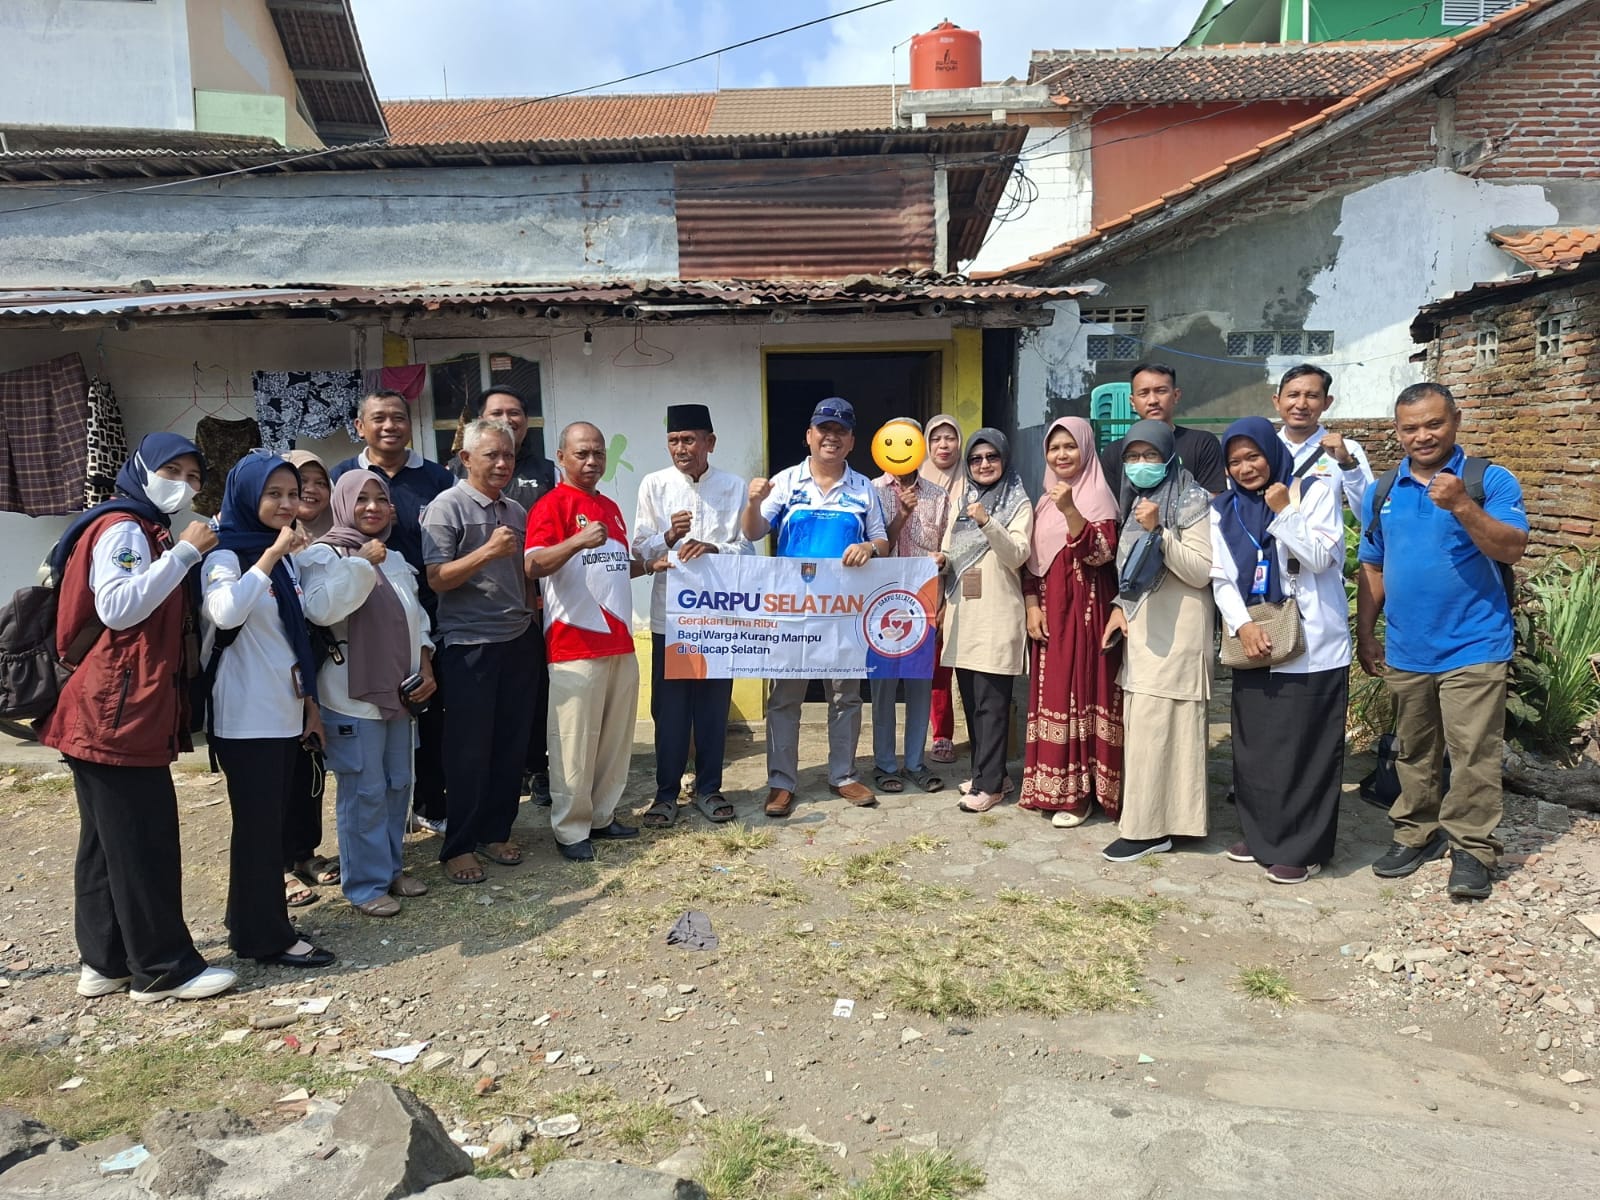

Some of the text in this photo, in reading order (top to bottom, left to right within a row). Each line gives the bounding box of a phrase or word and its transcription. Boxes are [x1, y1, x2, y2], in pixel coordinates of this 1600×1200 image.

[677, 589, 865, 614] GARPU SELATAN
[878, 593, 916, 607] GARPU SELATAN
[678, 616, 778, 629] Gerakan Lima Ribu
[678, 630, 822, 645] Bagi Warga Kurang Mampu
[677, 645, 771, 656] di Cilacap Selatan
